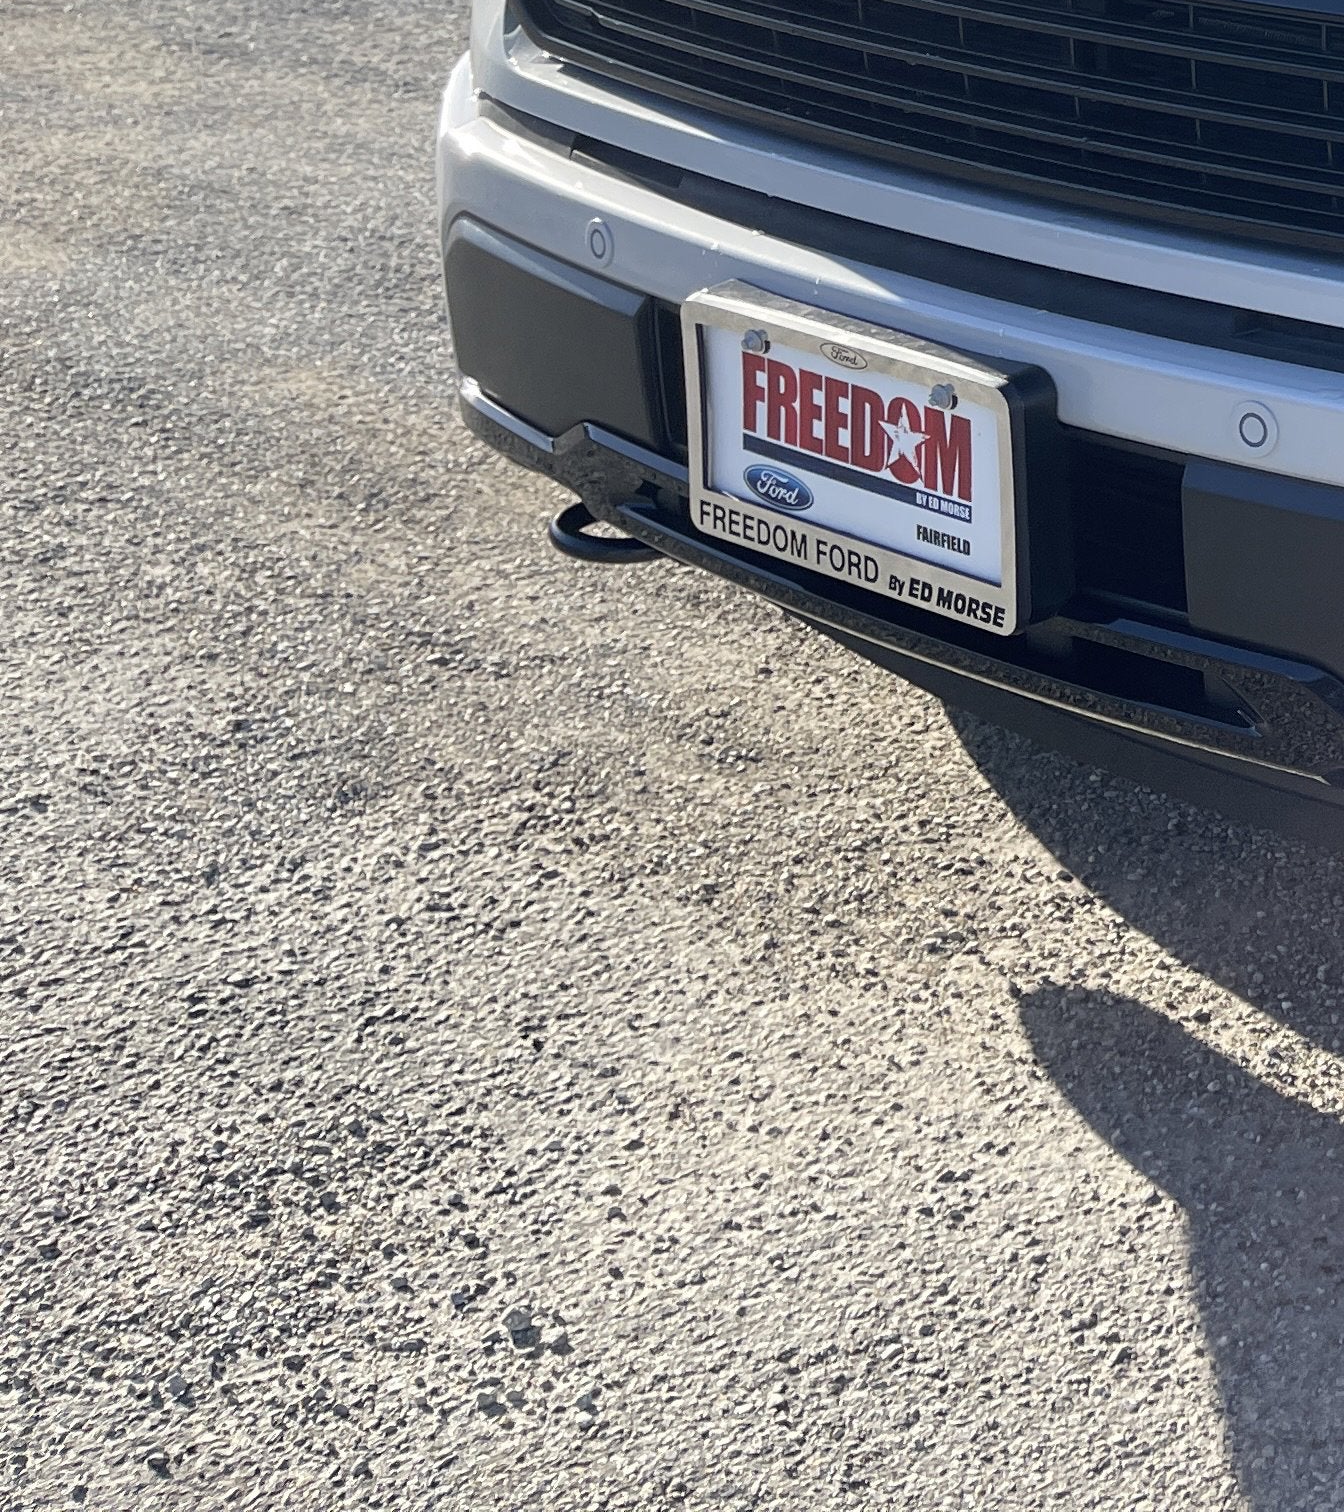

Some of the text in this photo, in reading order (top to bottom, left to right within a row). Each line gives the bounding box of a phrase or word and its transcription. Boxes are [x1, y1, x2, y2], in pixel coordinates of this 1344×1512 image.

[830, 346, 858, 365] Ford
[742, 351, 972, 502] FREEDOM
[756, 468, 800, 506] Ford
[916, 491, 970, 520] BY ED MORSE
[916, 524, 971, 556] FAIRFIELD
[700, 499, 808, 561] FREEDOM
[816, 538, 879, 584] FORD
[908, 578, 932, 603] ED
[936, 587, 1006, 628] MORSE
